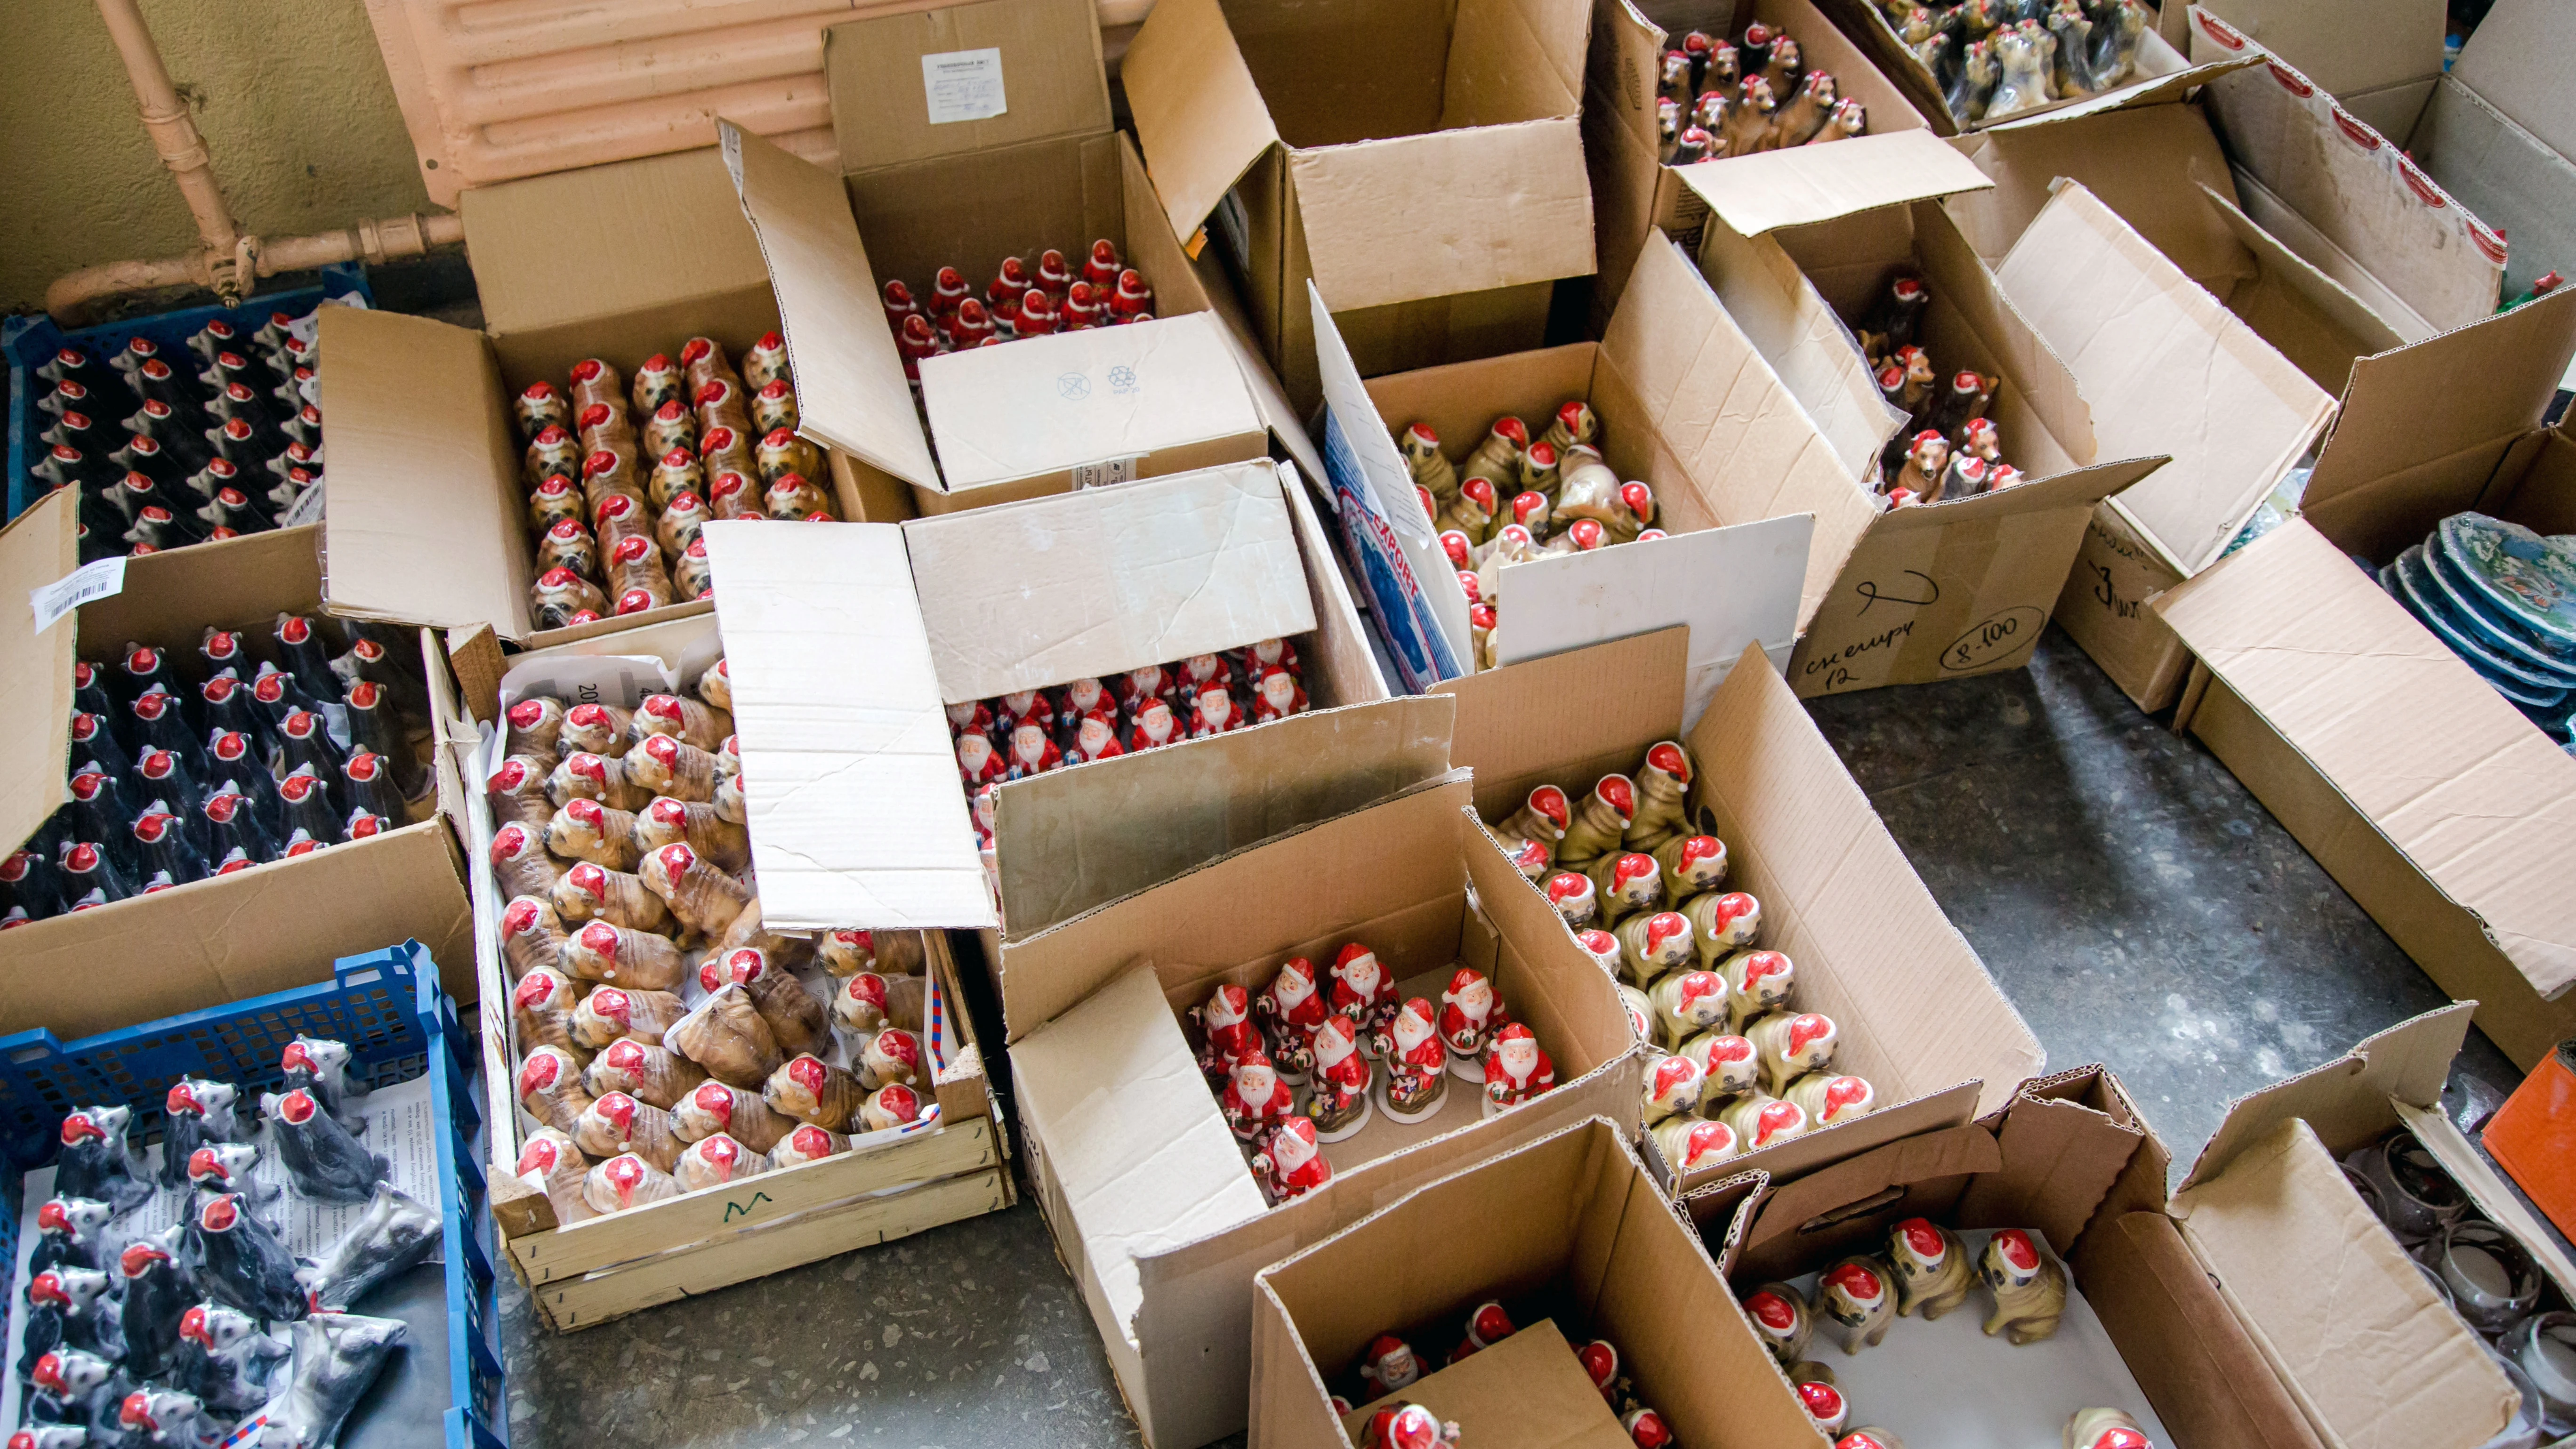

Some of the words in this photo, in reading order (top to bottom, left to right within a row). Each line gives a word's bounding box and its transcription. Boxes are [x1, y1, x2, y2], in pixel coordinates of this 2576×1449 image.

[1373, 513, 1419, 598] EXPORT
[1825, 667, 1860, 691] 12
[408, 1120, 412, 1128] мм
